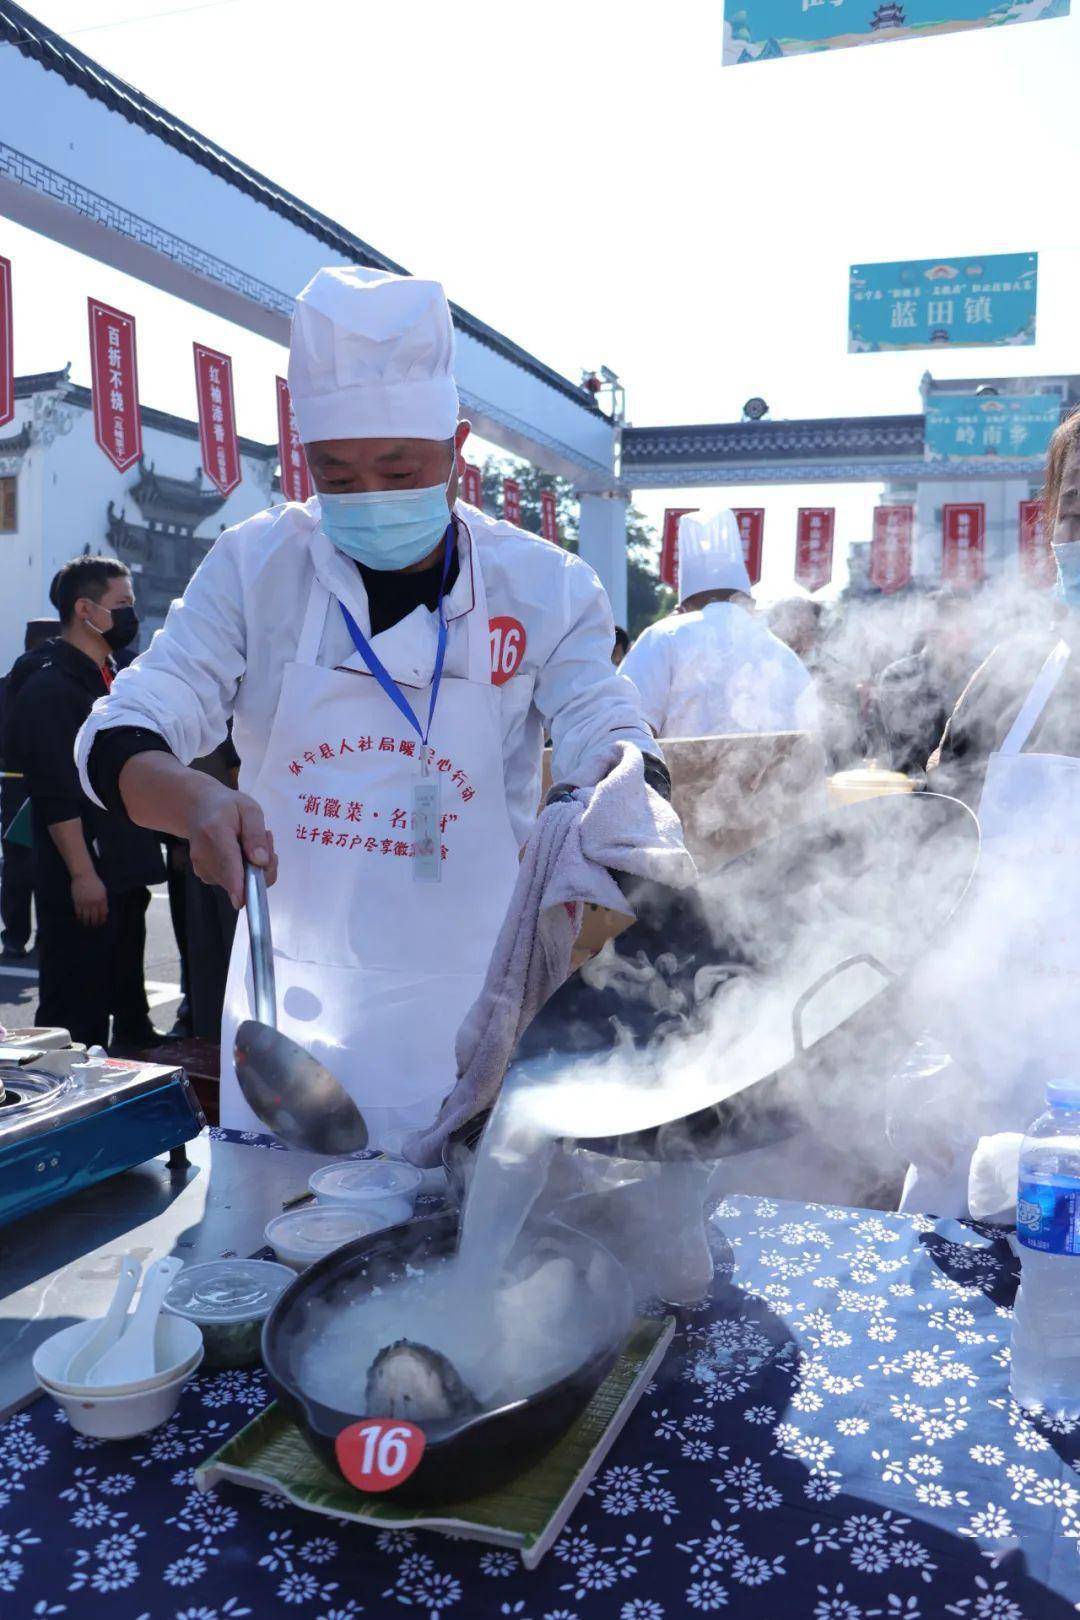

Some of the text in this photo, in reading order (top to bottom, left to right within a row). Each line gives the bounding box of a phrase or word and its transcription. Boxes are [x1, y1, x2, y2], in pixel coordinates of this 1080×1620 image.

[890, 296, 992, 328] 蓝田镇
[489, 628, 520, 674] 16
[298, 793, 459, 833] “新徽菜·名”
[359, 1426, 412, 1476] 16
